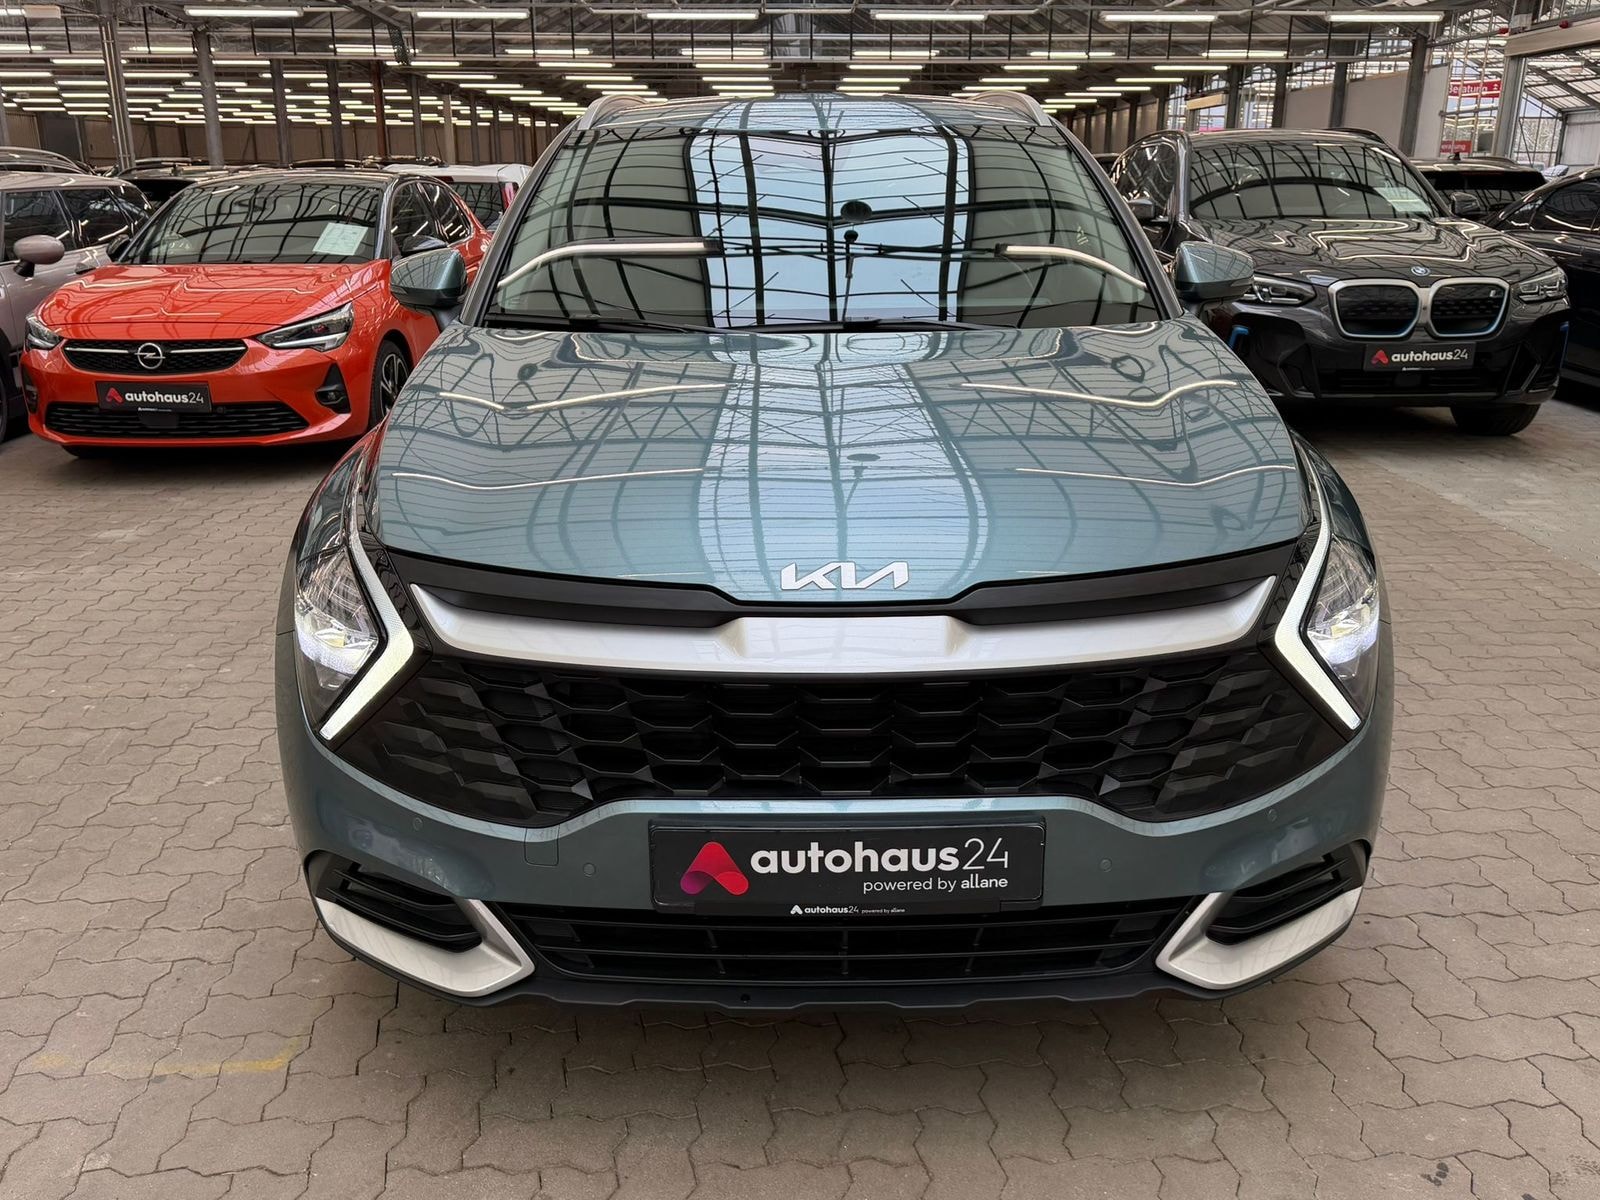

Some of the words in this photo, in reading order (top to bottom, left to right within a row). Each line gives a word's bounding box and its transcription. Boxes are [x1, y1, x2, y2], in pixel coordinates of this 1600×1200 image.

[1449, 85, 1488, 94] Beatung
[1391, 348, 1468, 362] autohaus24
[125, 390, 204, 403] autohaus24
[780, 560, 909, 590] KIA
[750, 838, 1009, 874] autohaus24
[863, 877, 933, 894] powered
[937, 876, 957, 892] by
[960, 873, 1009, 889] allane
[804, 905, 859, 914] autohaus24
